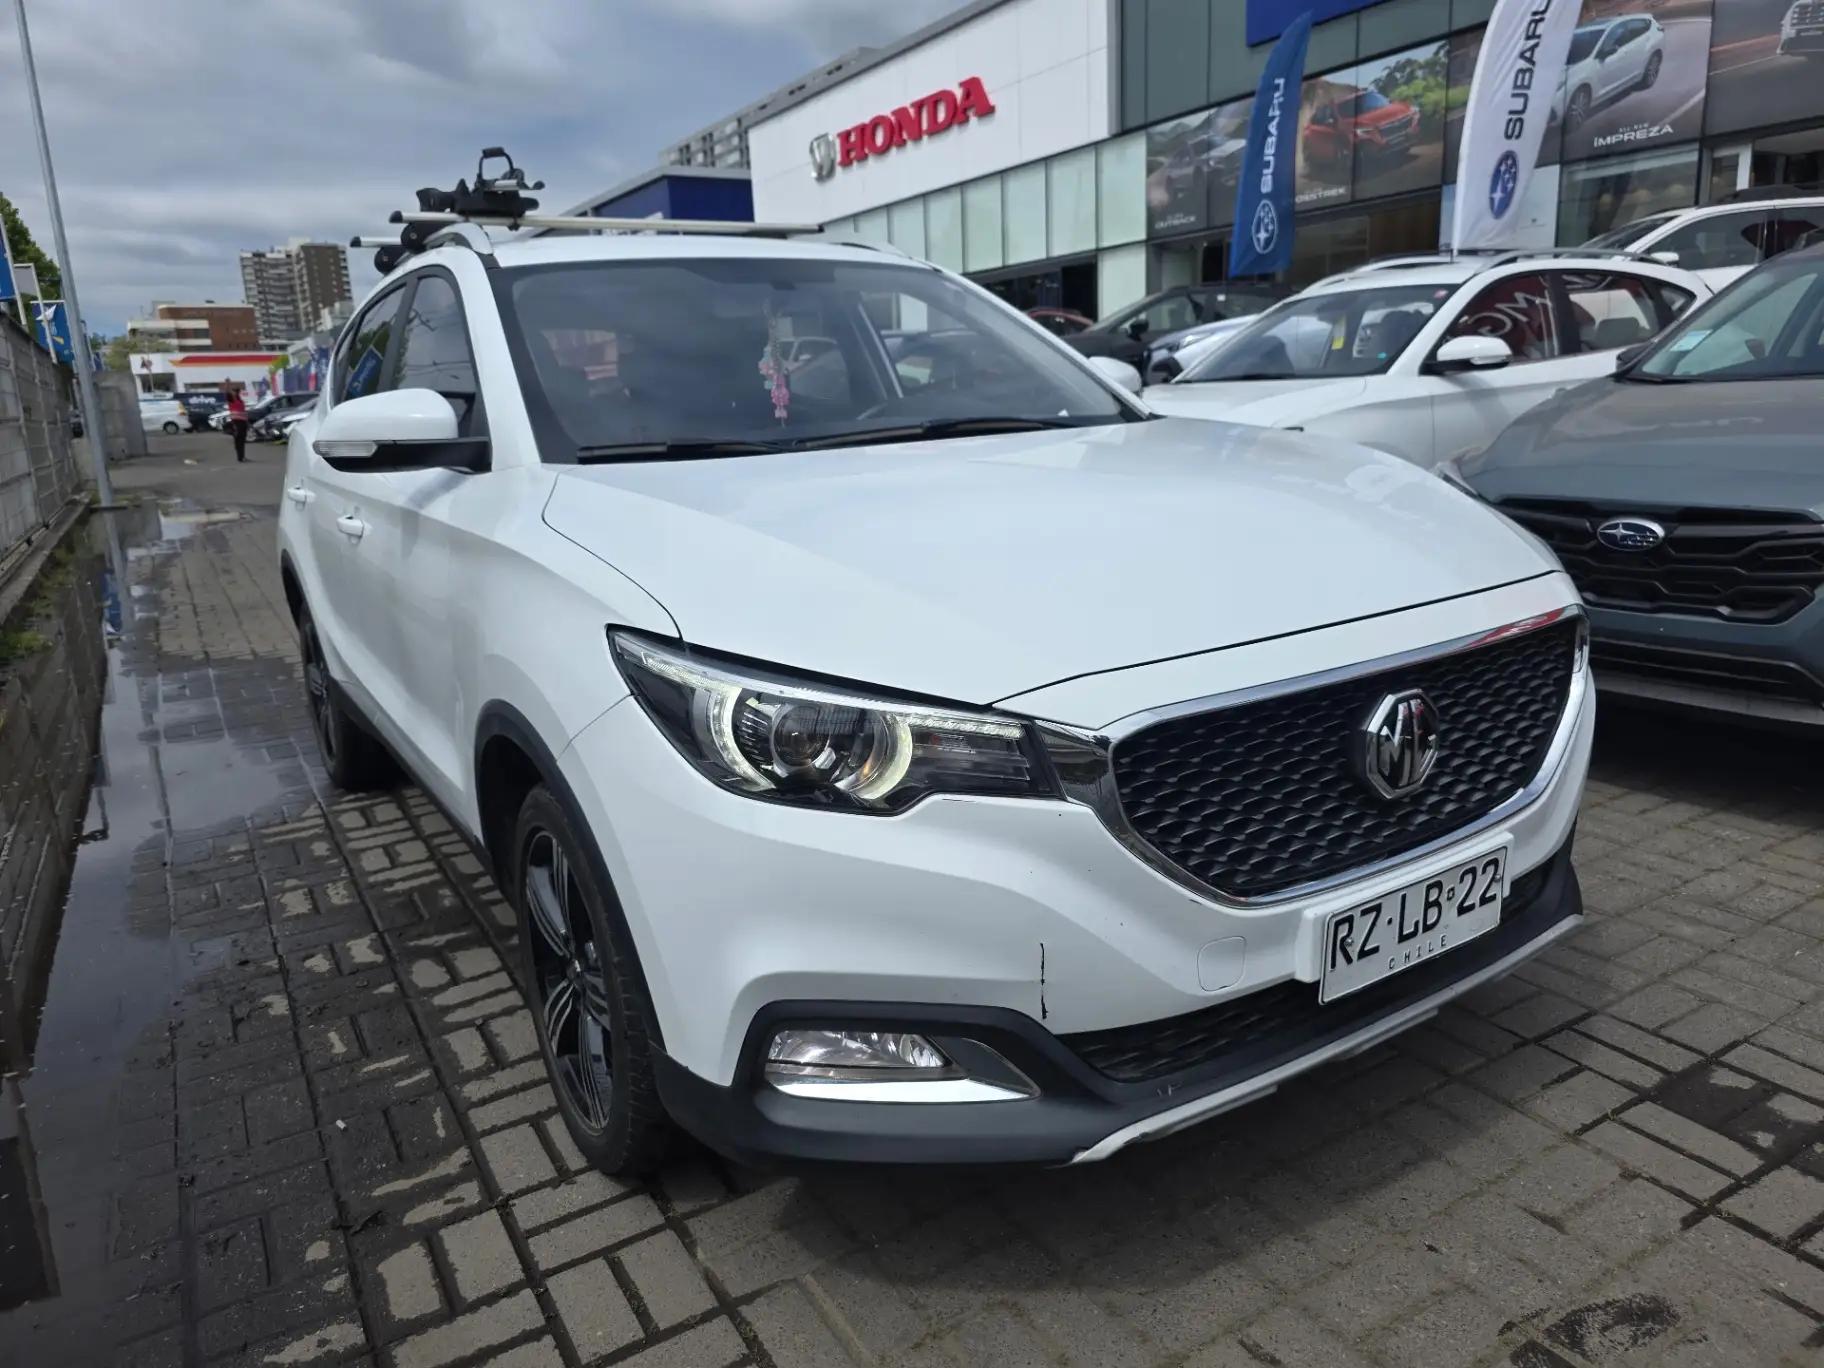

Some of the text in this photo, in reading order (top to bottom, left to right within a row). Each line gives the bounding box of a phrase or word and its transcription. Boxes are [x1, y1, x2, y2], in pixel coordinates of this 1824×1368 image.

[837, 76, 995, 168] HONDA
[1260, 77, 1286, 194] SUBARU
[1593, 123, 1674, 148] IMPREZA
[1378, 698, 1438, 788] MG
[1387, 934, 1448, 970] CHILE
